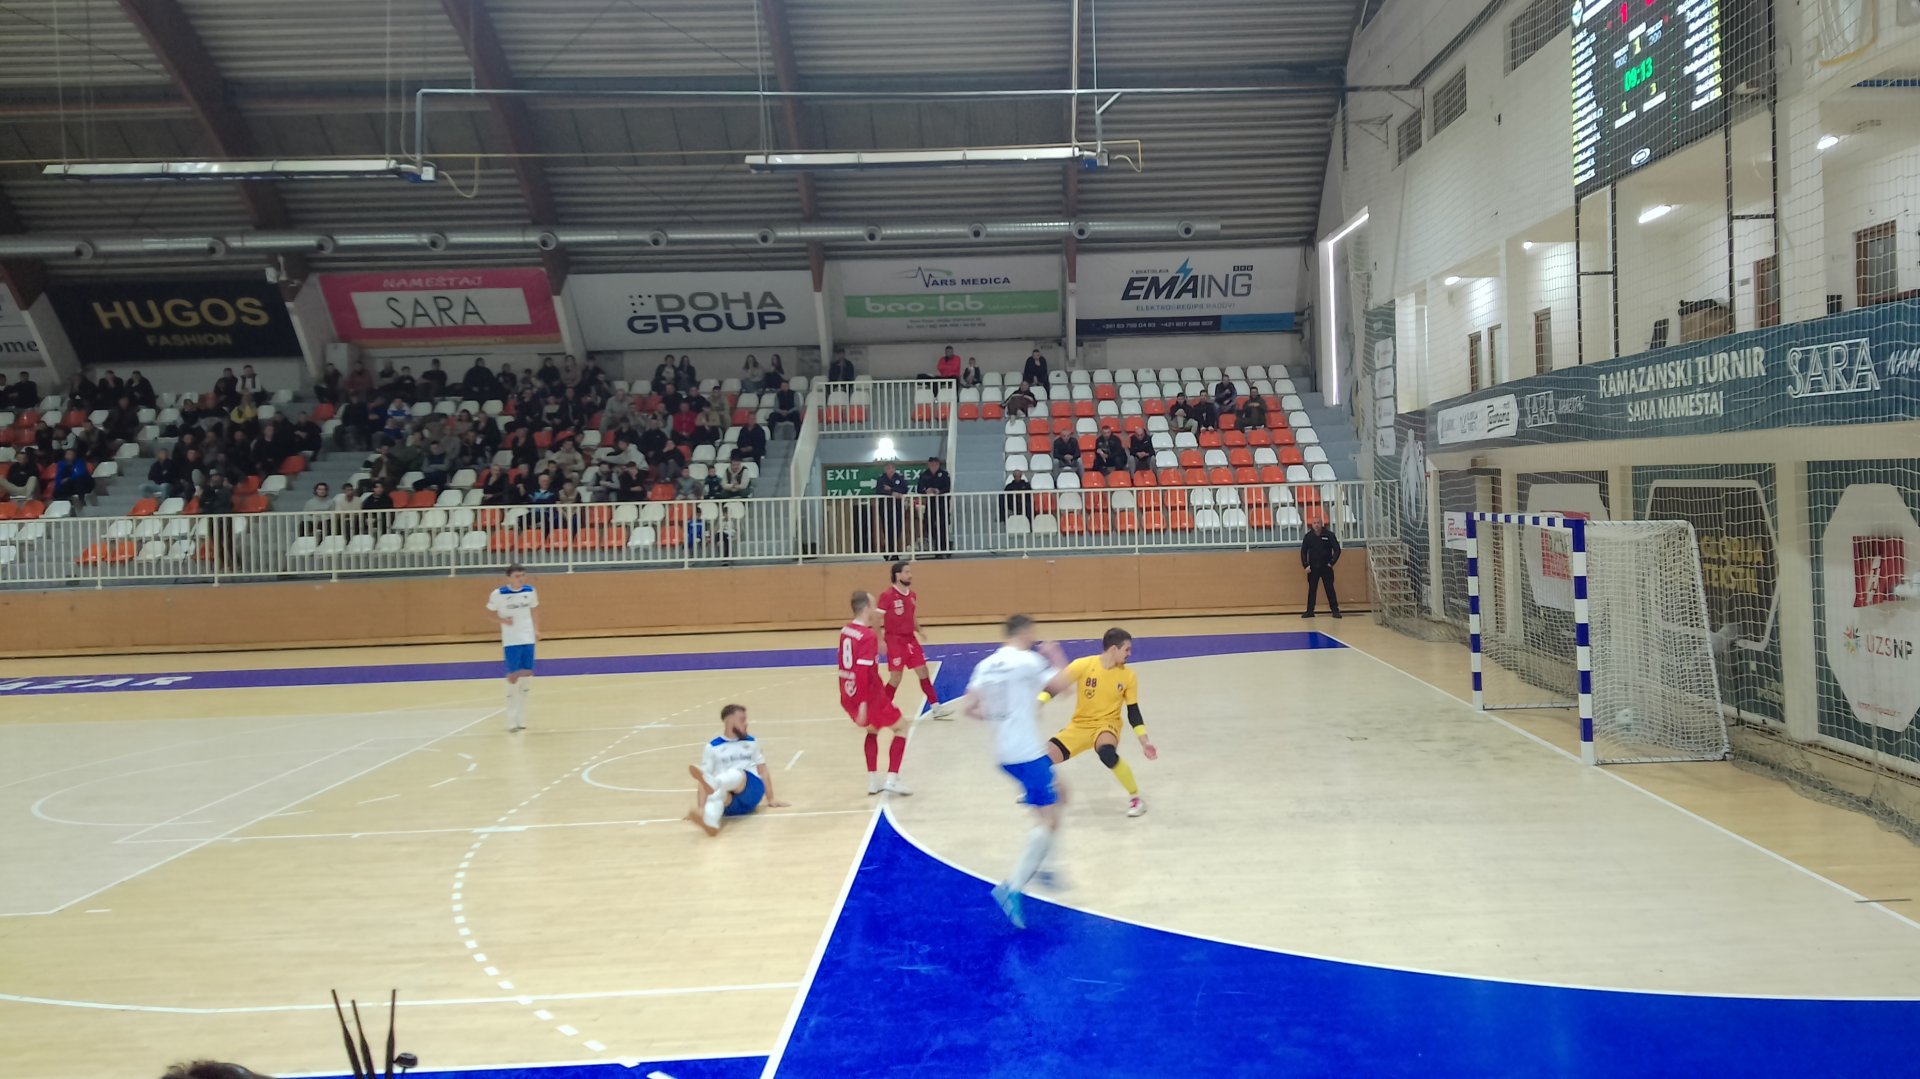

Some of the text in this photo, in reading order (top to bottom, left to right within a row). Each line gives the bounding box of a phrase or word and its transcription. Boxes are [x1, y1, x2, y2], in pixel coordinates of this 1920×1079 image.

[961, 277, 1011, 286] MEDICA
[1121, 273, 1253, 301] EMAING
[92, 297, 270, 329] HUGOS
[386, 295, 487, 329] SARA
[654, 291, 784, 313] DOHA
[627, 311, 787, 334] GROUP
[0, 340, 39, 353] me
[146, 333, 233, 348] FASHION
[1600, 346, 1767, 399] RAMAZANSKI TURNIR
[1787, 337, 1880, 399] SARA
[1524, 390, 1557, 428] SARA
[1628, 398, 1657, 423] SARA
[826, 469, 860, 481] EXIT
[842, 637, 853, 670] 8
[1866, 633, 1914, 660] UZSNP
[1085, 676, 1098, 689] 88
